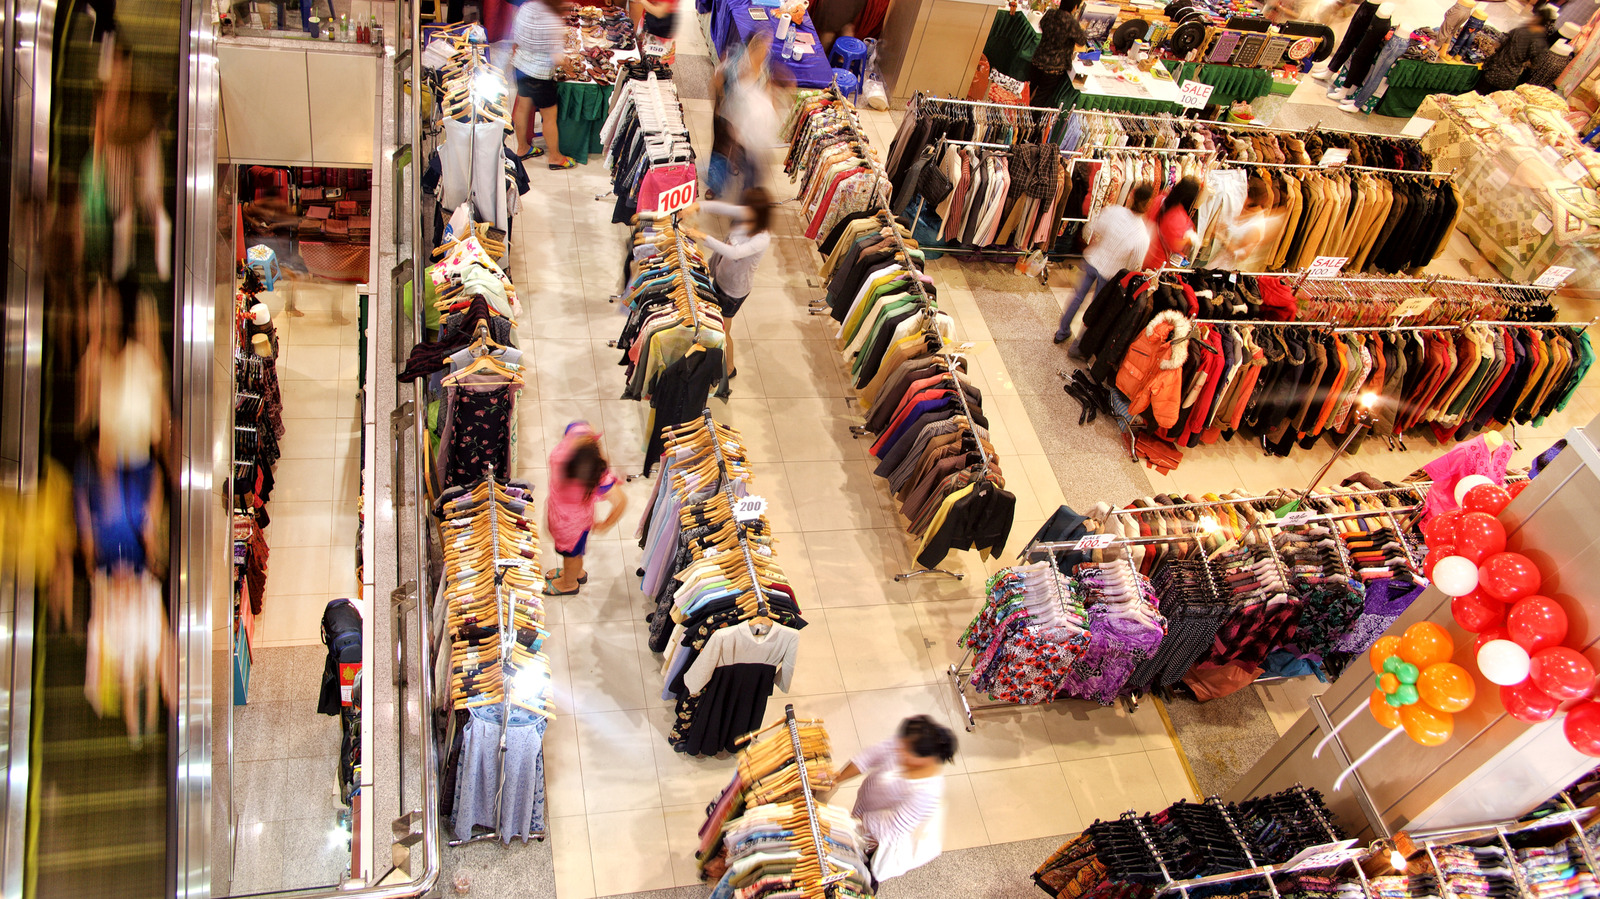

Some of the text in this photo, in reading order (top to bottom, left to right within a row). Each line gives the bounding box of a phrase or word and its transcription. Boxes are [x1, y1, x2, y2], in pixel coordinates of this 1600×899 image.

[1182, 83, 1211, 98] SALE
[660, 184, 692, 212] 100
[1313, 258, 1346, 268] SALE
[1544, 267, 1572, 278] SALE
[739, 501, 762, 512] 200
